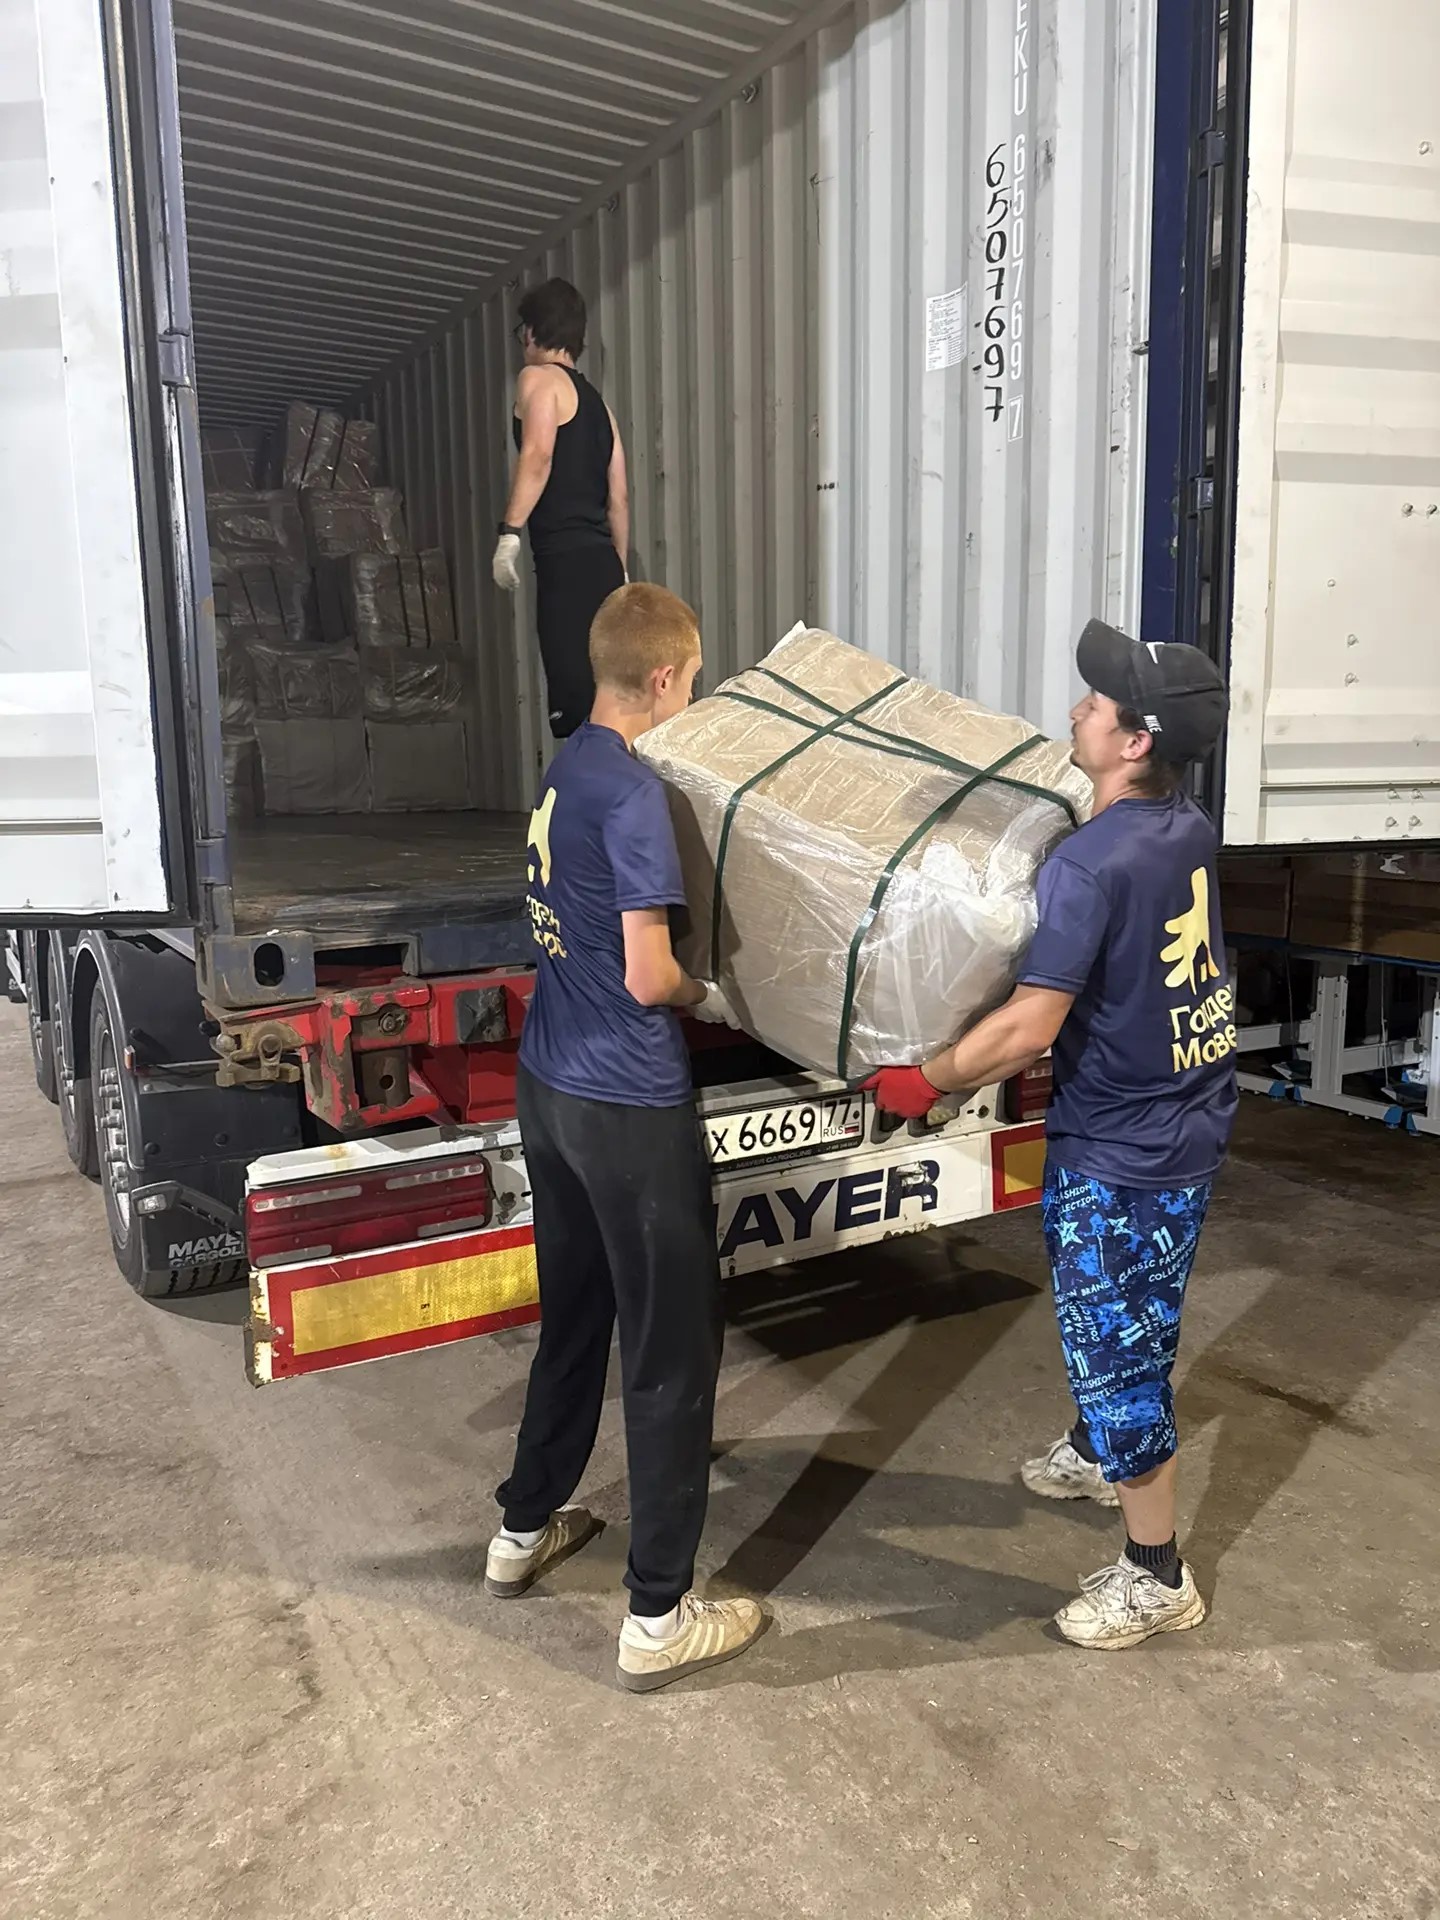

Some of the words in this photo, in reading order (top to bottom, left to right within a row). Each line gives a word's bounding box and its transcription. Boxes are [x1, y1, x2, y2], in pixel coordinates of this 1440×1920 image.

[1009, 134, 1026, 380] 650769
[983, 143, 1012, 422] 6507697
[1143, 714, 1163, 733] NIKE
[703, 1128, 730, 1158] X
[738, 1106, 816, 1152] 6669
[823, 1125, 845, 1137] RUS
[824, 1101, 852, 1127] 77
[714, 1159, 941, 1258] AYER
[168, 1231, 242, 1259] MAYE
